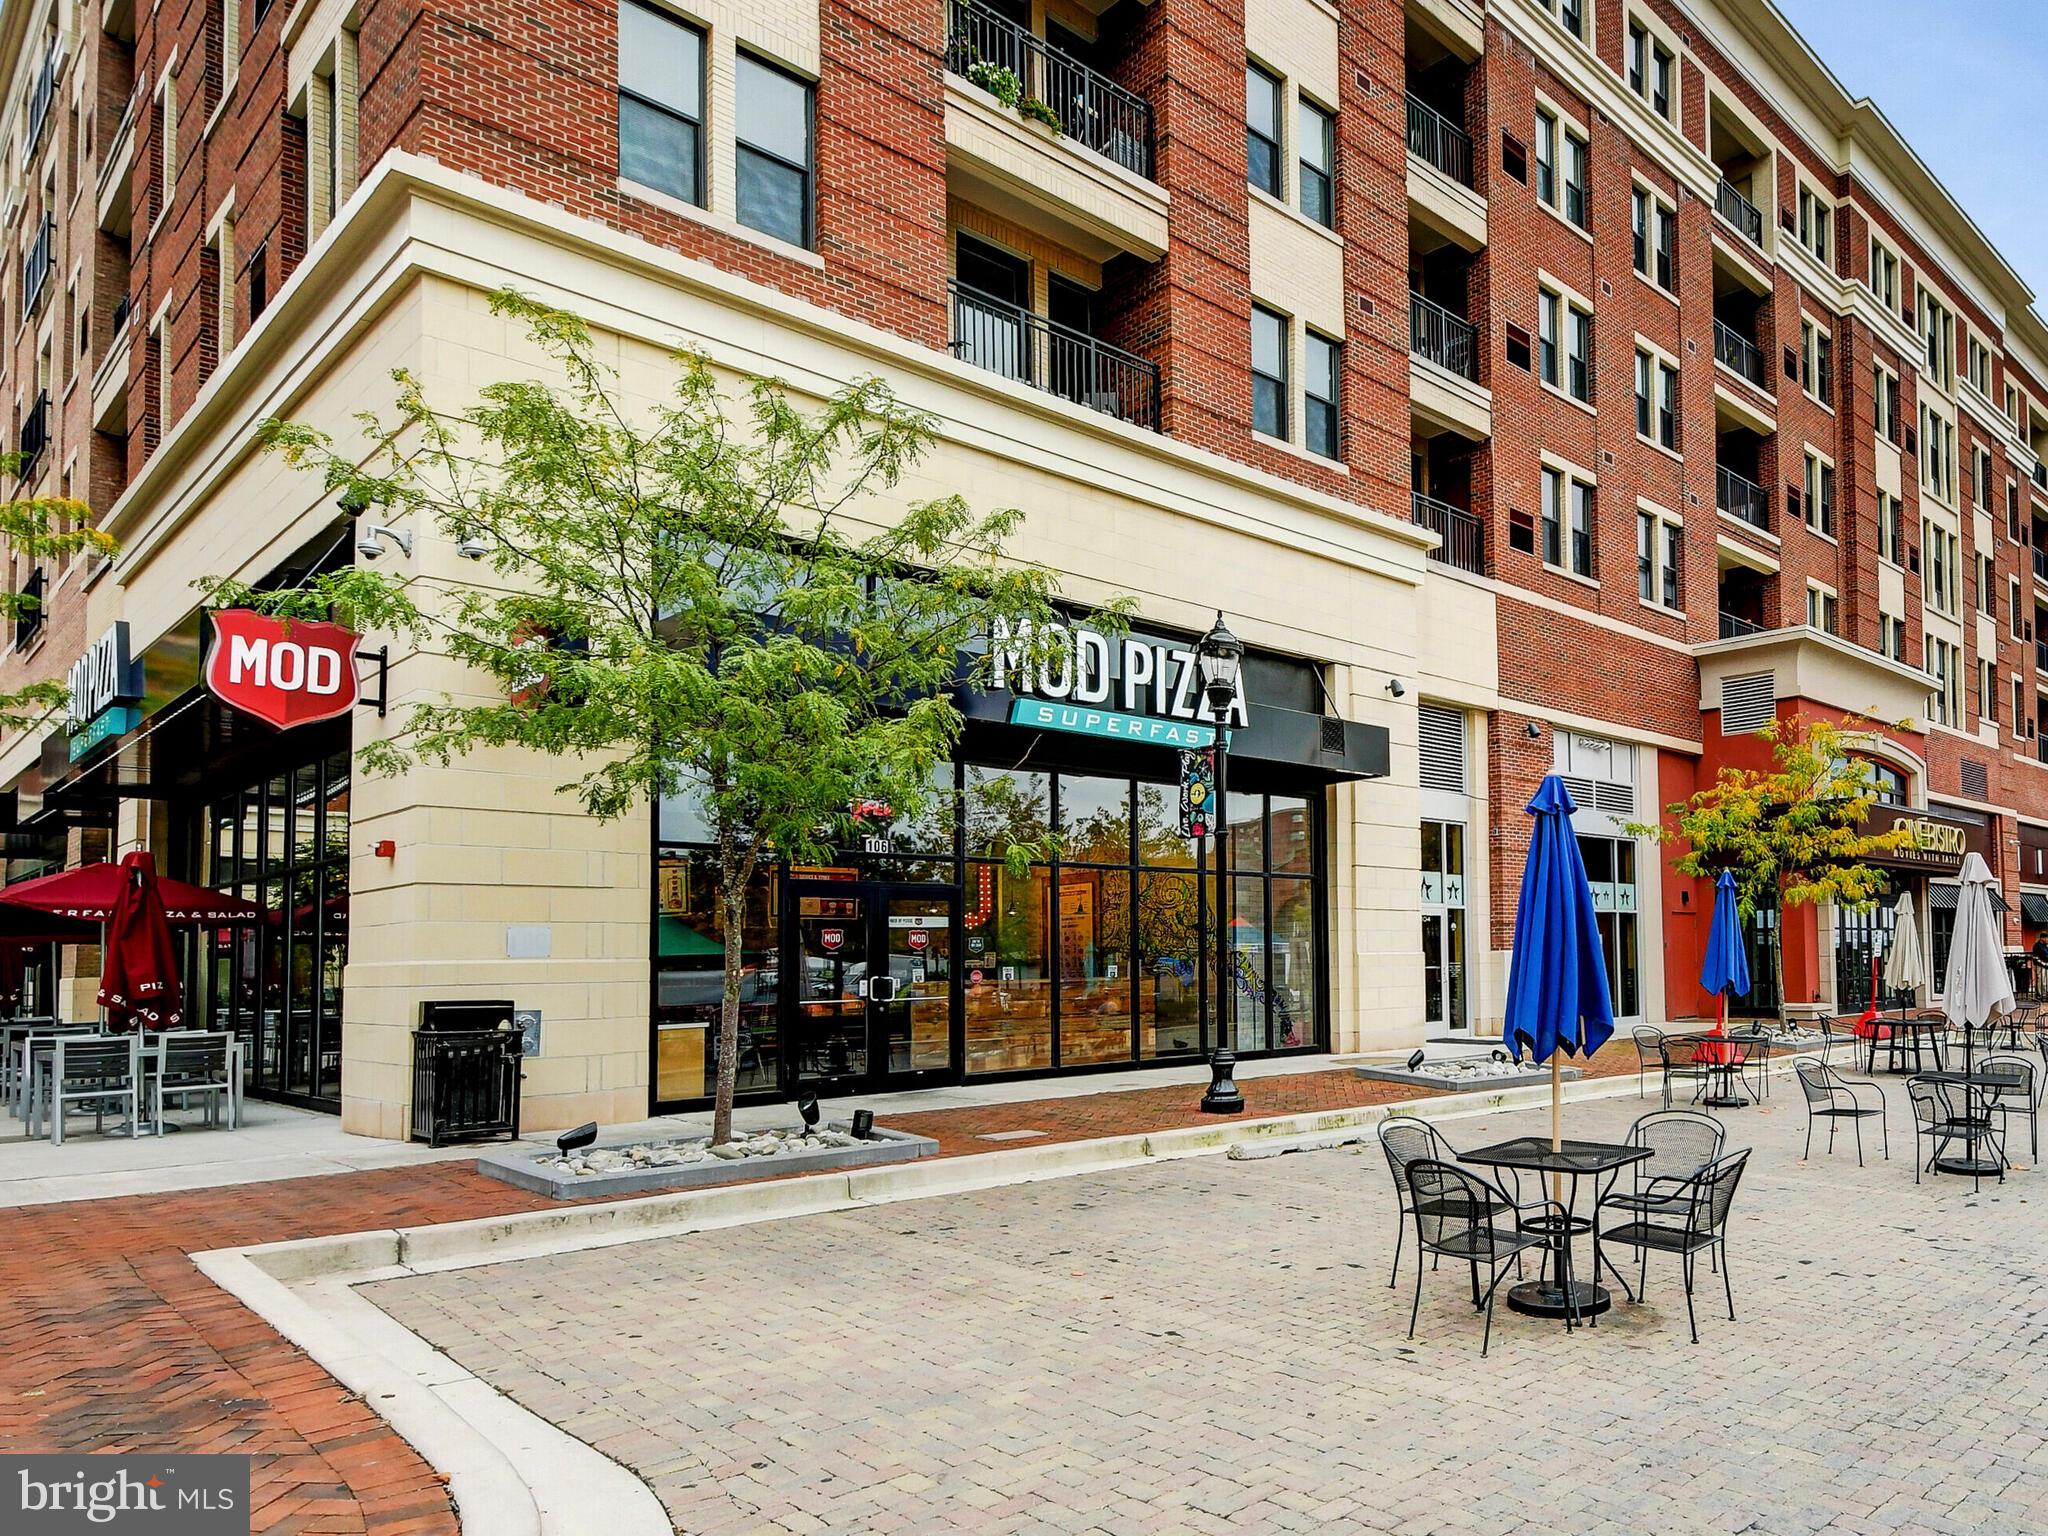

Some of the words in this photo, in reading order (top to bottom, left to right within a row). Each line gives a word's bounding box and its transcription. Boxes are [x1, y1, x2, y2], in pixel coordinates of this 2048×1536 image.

[992, 613, 1109, 703] MOD
[229, 635, 341, 695] MOD
[1037, 707, 1216, 746] SUPERFAST
[867, 840, 887, 853] 106
[207, 911, 257, 919] SALAD
[823, 932, 841, 944] MOD
[910, 934, 927, 944] MOD
